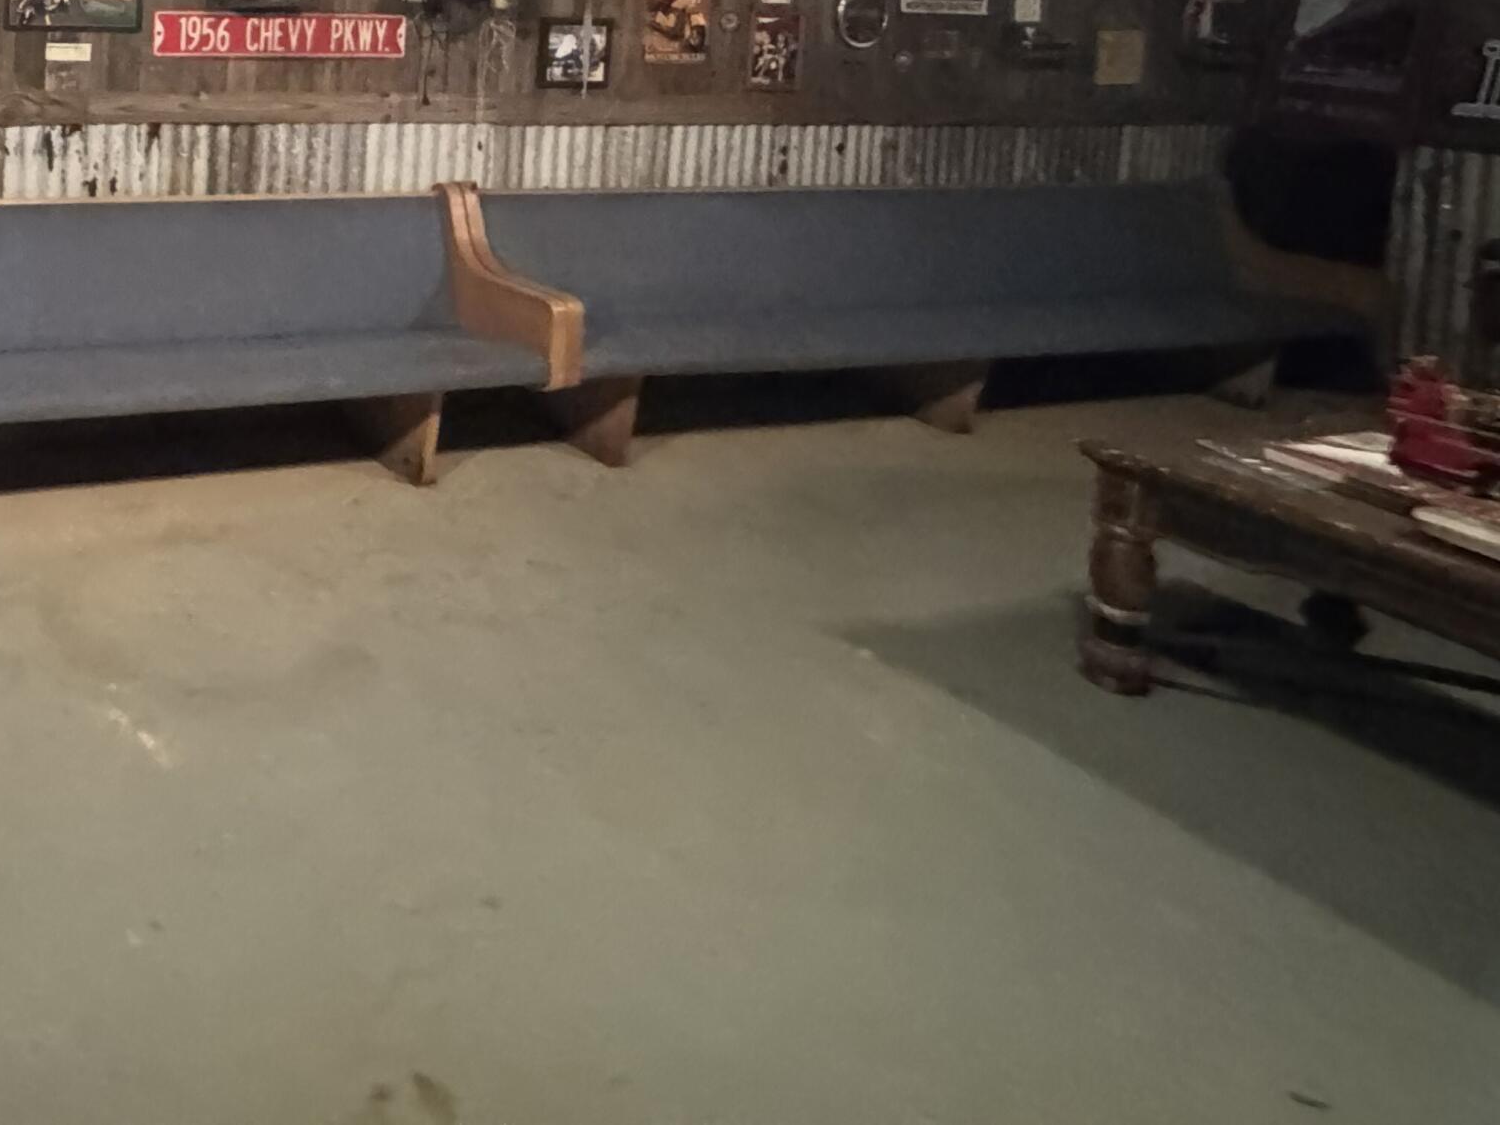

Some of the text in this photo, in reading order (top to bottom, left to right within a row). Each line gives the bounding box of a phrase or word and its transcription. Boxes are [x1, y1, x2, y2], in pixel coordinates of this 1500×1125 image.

[179, 16, 390, 52] 1956 CHEVY PKWY.
